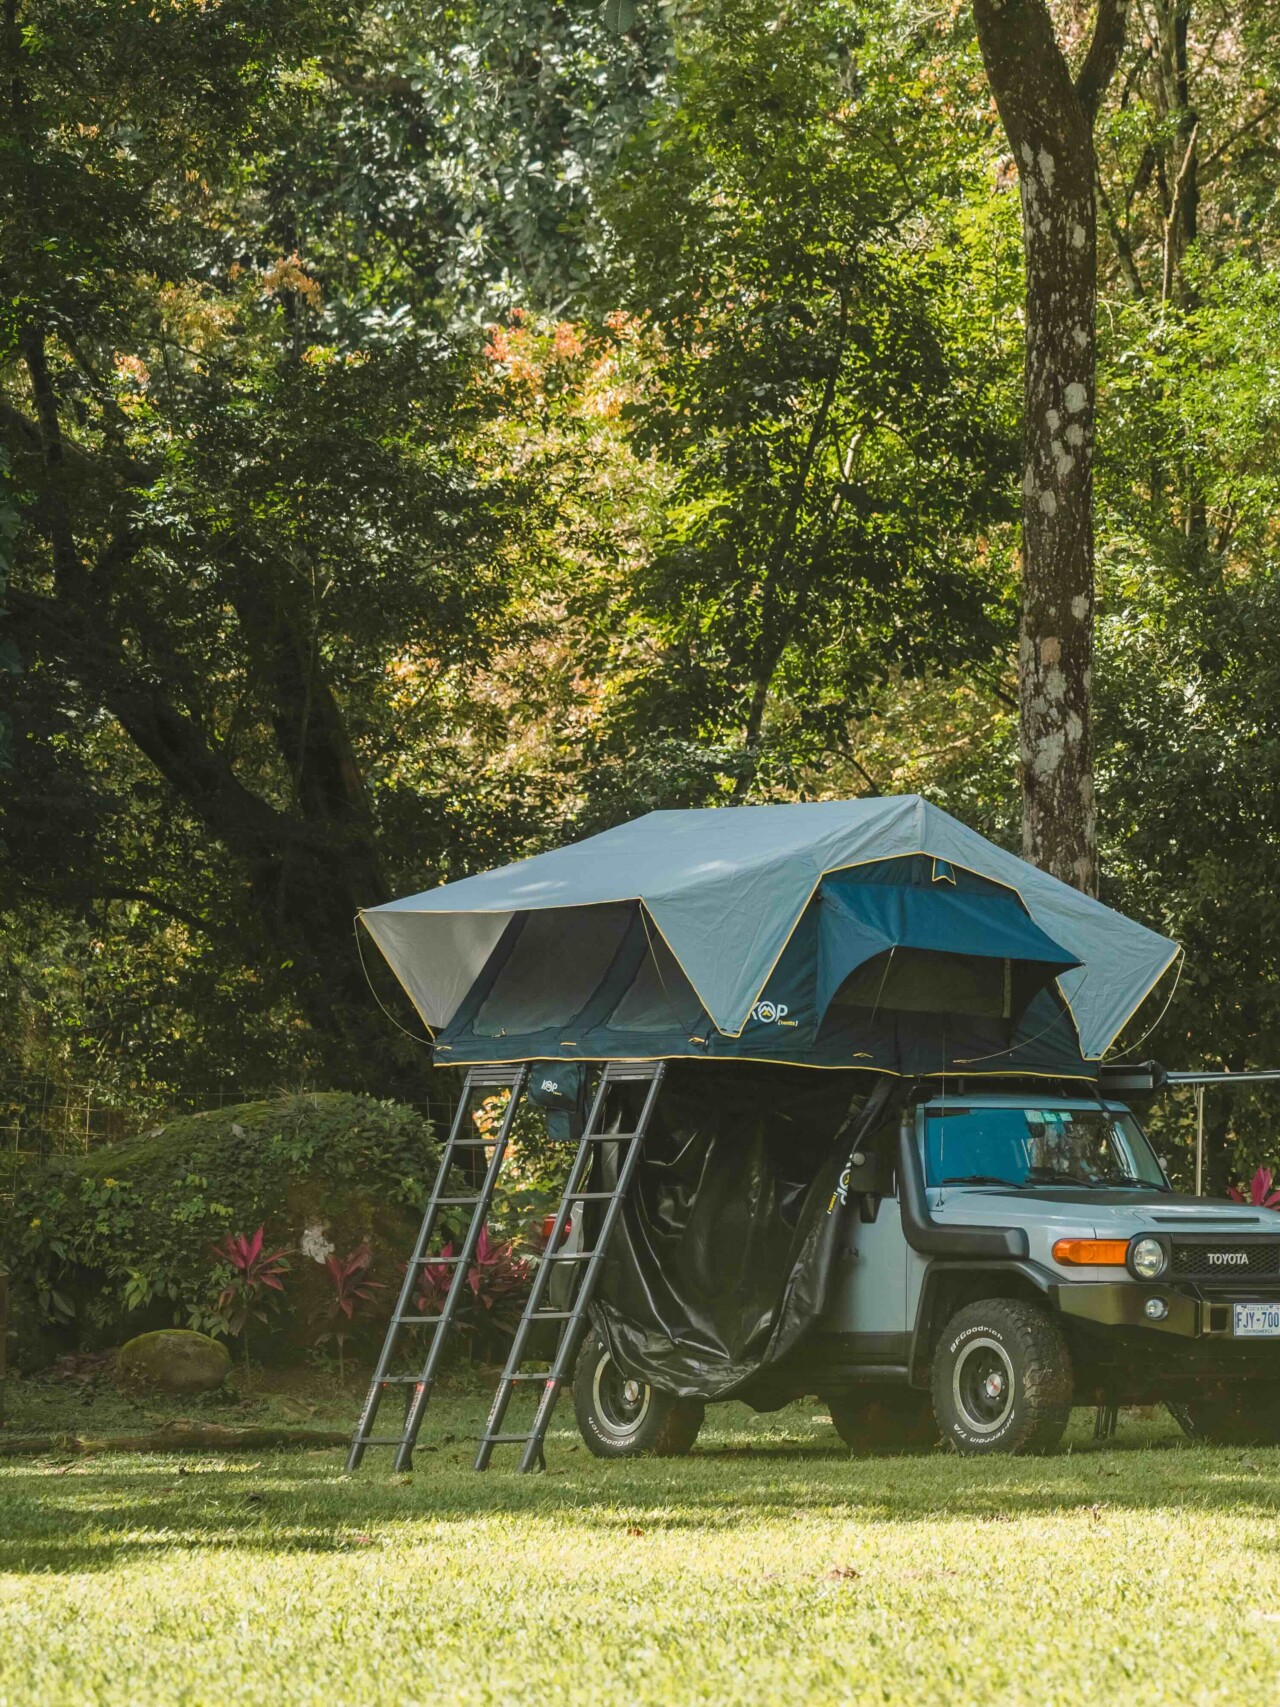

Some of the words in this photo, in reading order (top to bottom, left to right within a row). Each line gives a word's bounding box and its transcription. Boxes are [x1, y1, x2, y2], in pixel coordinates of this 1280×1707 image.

[1207, 1253, 1249, 1264] TOYOTA
[1236, 1312, 1279, 1328] FJY-700
[950, 1325, 1003, 1353] BFGoodrich
[588, 1416, 636, 1447] BFGoodrich
[953, 1423, 967, 1439] T/A
